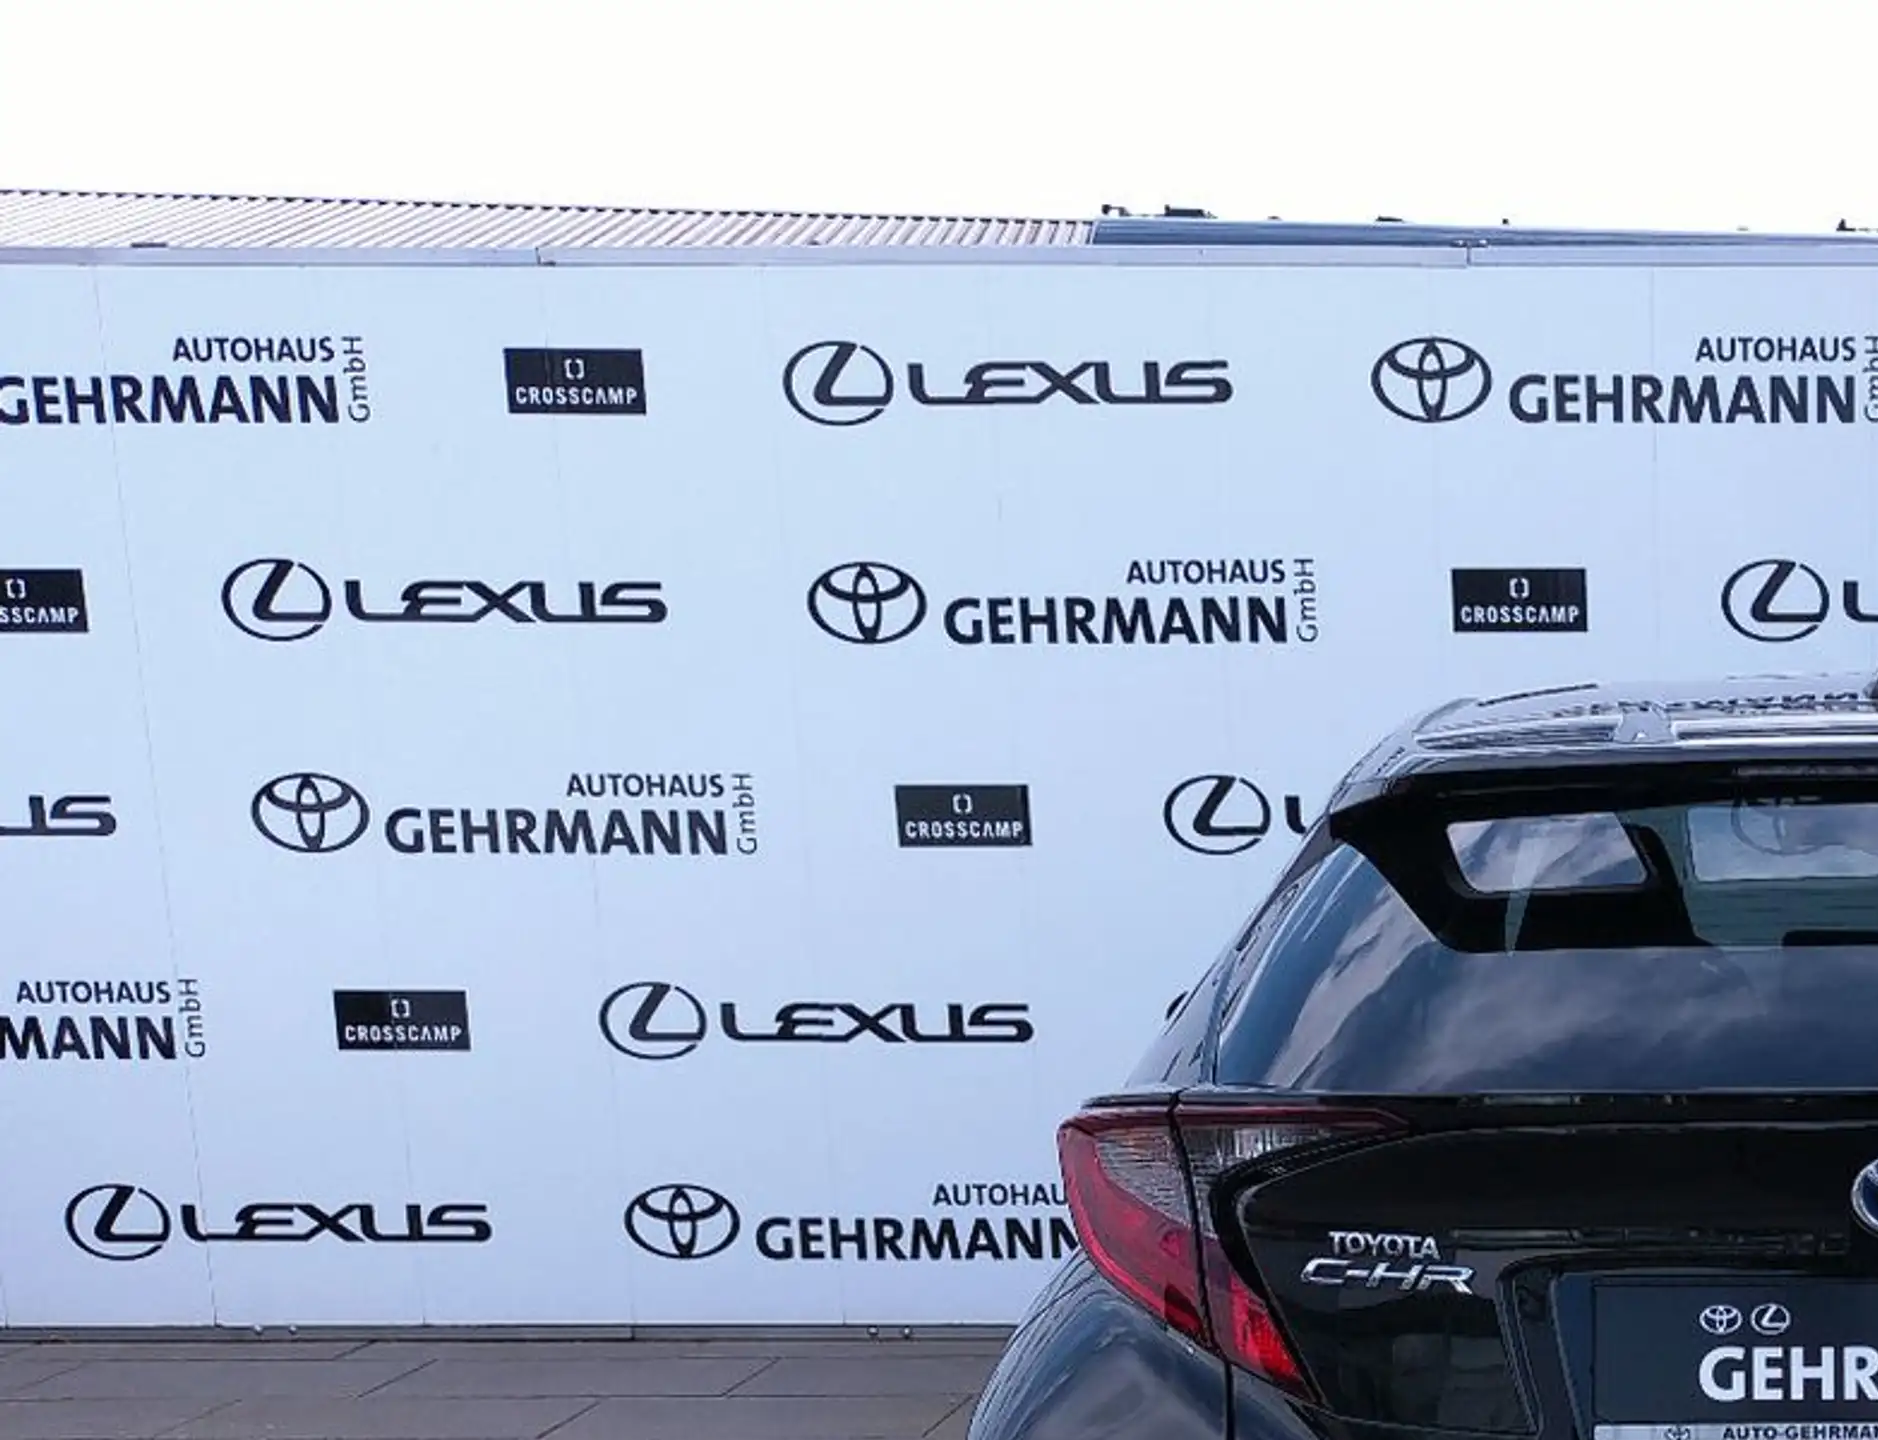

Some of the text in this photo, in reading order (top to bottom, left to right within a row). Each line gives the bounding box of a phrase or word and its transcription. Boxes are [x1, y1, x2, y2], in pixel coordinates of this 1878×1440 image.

[173, 337, 334, 362] AUTOHAUS
[1696, 337, 1856, 362] AUTOHAUS
[342, 337, 370, 423] GmbH
[516, 387, 637, 404] CROSSCAMP
[908, 361, 1233, 405] LEXUS
[0, 375, 339, 424] GEHRMANN
[1510, 375, 1854, 423] GEHRMANN
[1127, 560, 1285, 584] AUTOHAUS
[345, 580, 667, 623] LEXUS
[1293, 559, 1318, 642] GmbH
[1461, 606, 1579, 623] CROSSCAMP
[944, 596, 1287, 644] GEHRMANN
[567, 774, 724, 797] AUTOHAUS
[385, 808, 727, 855] GEHRMANN
[732, 774, 757, 855] GmbH
[906, 821, 1023, 838] CROSSCAMP
[17, 981, 171, 1003] AUTOHAUS
[178, 979, 205, 1057] GmbH
[346, 1026, 461, 1041] CROSSCAMP
[721, 1003, 1033, 1042] LEXUS
[933, 1183, 1068, 1206] AUTOHAU
[181, 1204, 491, 1242] LEXUS
[1328, 1231, 1441, 1260] TOYOTA
[1301, 1258, 1474, 1294] C-HR
